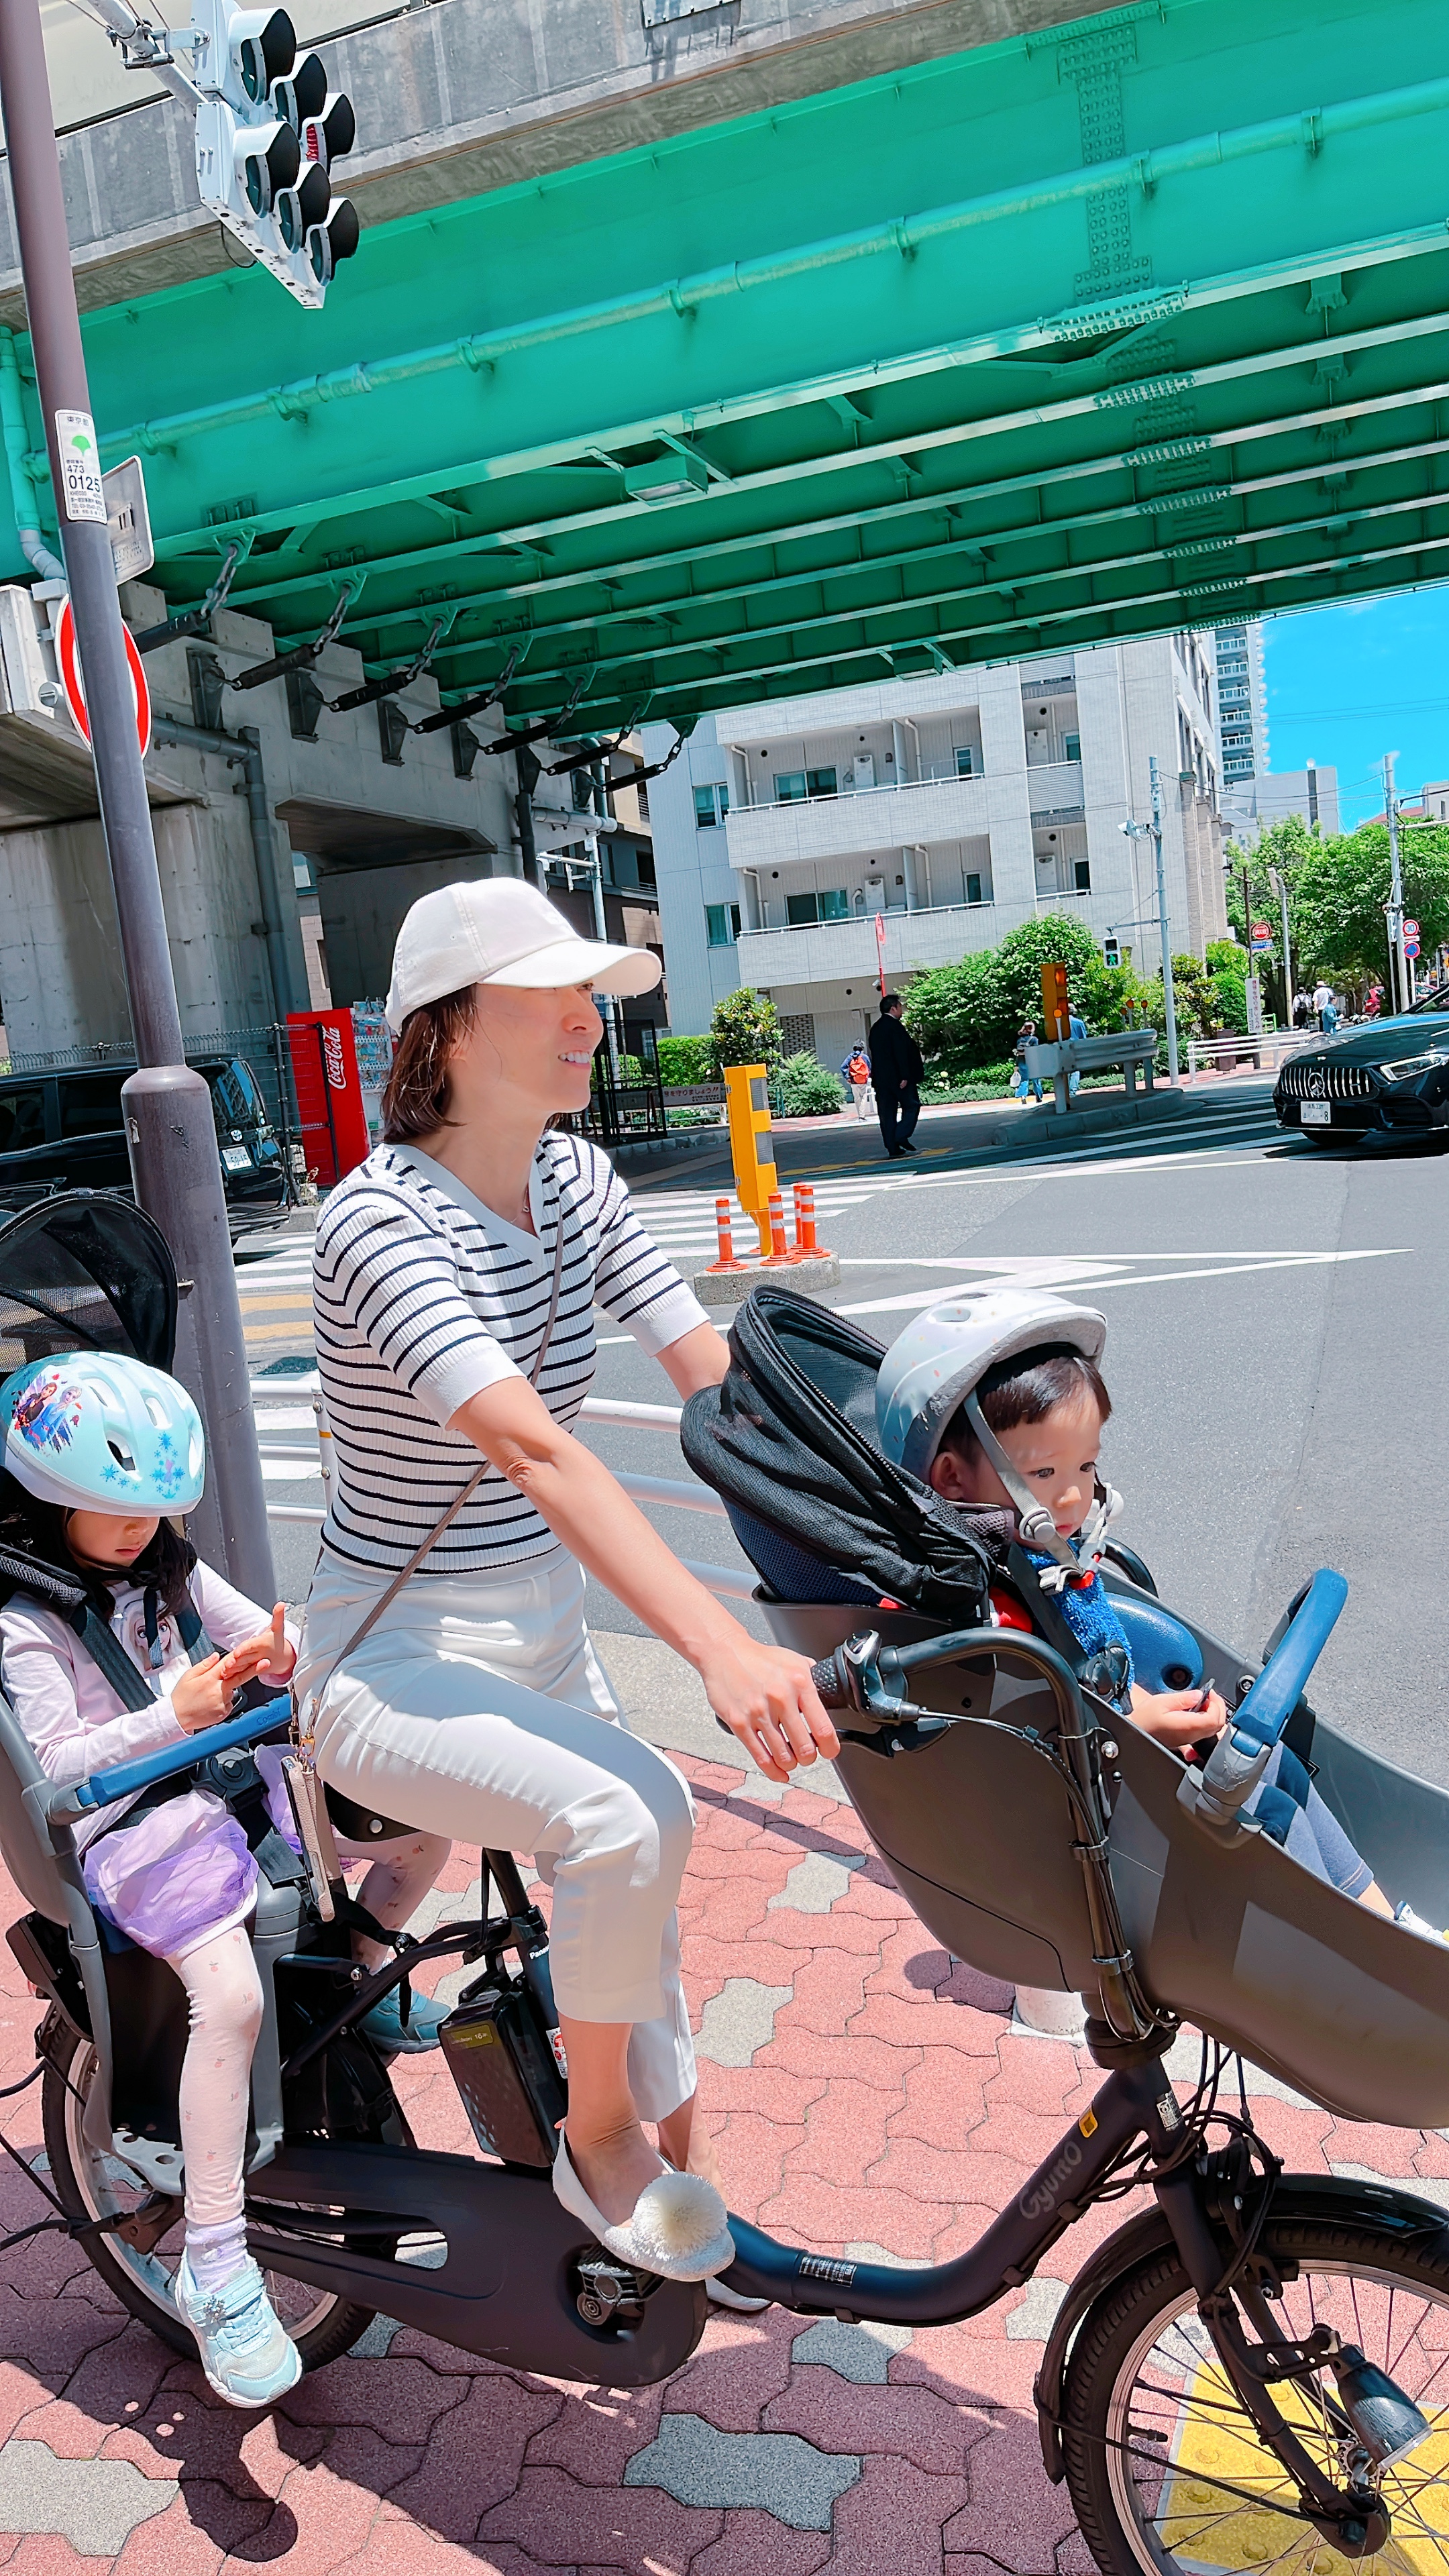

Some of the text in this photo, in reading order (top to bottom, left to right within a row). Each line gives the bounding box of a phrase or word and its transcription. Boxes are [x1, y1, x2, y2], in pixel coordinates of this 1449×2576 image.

[67, 465, 85, 473] 473
[69, 475, 100, 492] 0125
[323, 1026, 347, 1089] Coca-Cola
[1324, 1111, 1329, 1122] 8
